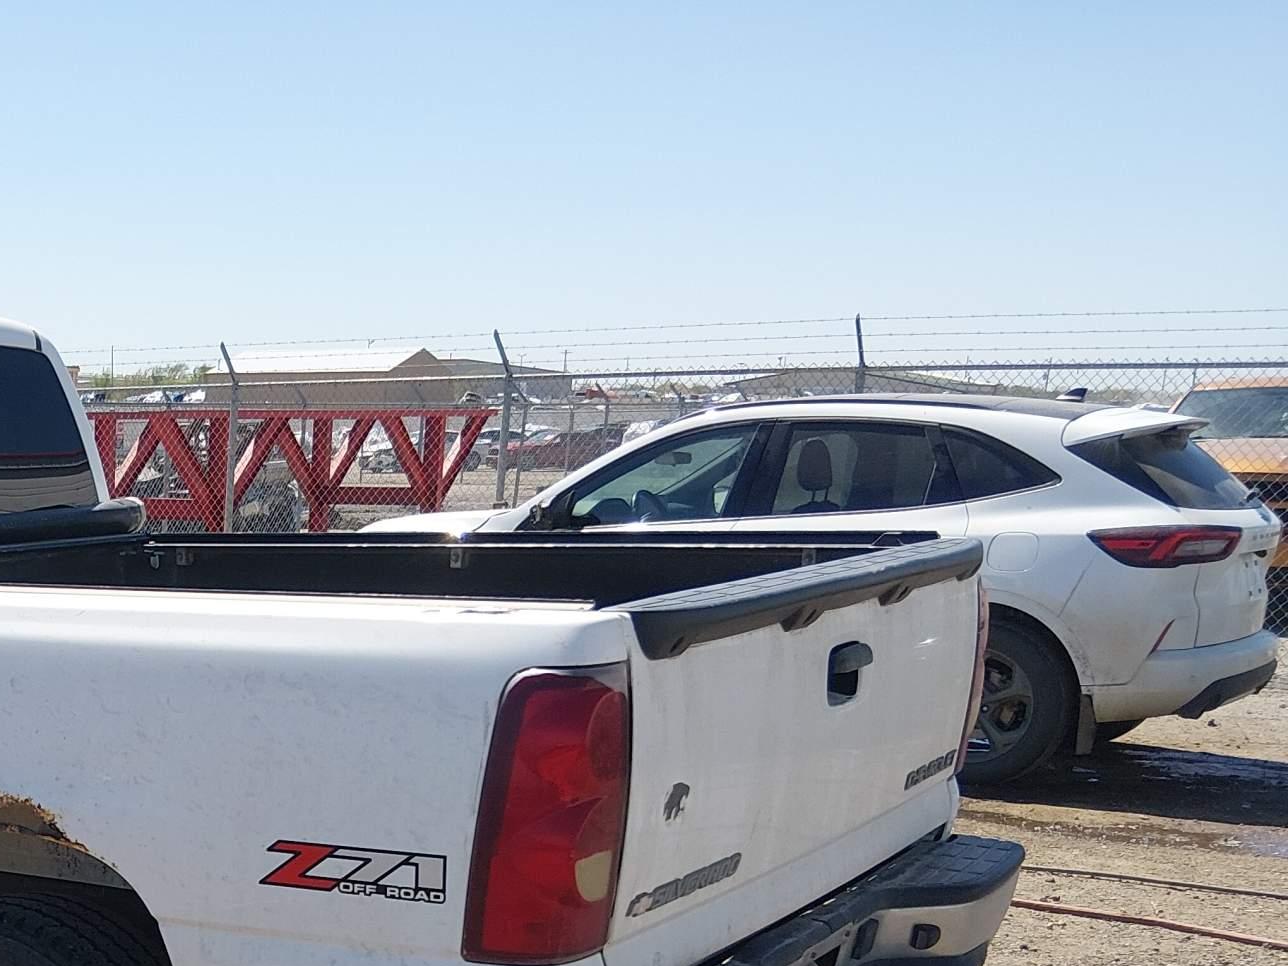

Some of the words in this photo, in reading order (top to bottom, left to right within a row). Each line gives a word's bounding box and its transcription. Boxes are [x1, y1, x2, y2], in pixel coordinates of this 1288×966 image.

[259, 840, 447, 891] Z71
[651, 852, 742, 910] SILVERADO
[338, 881, 377, 896] OFF
[386, 886, 445, 903] ROAD
